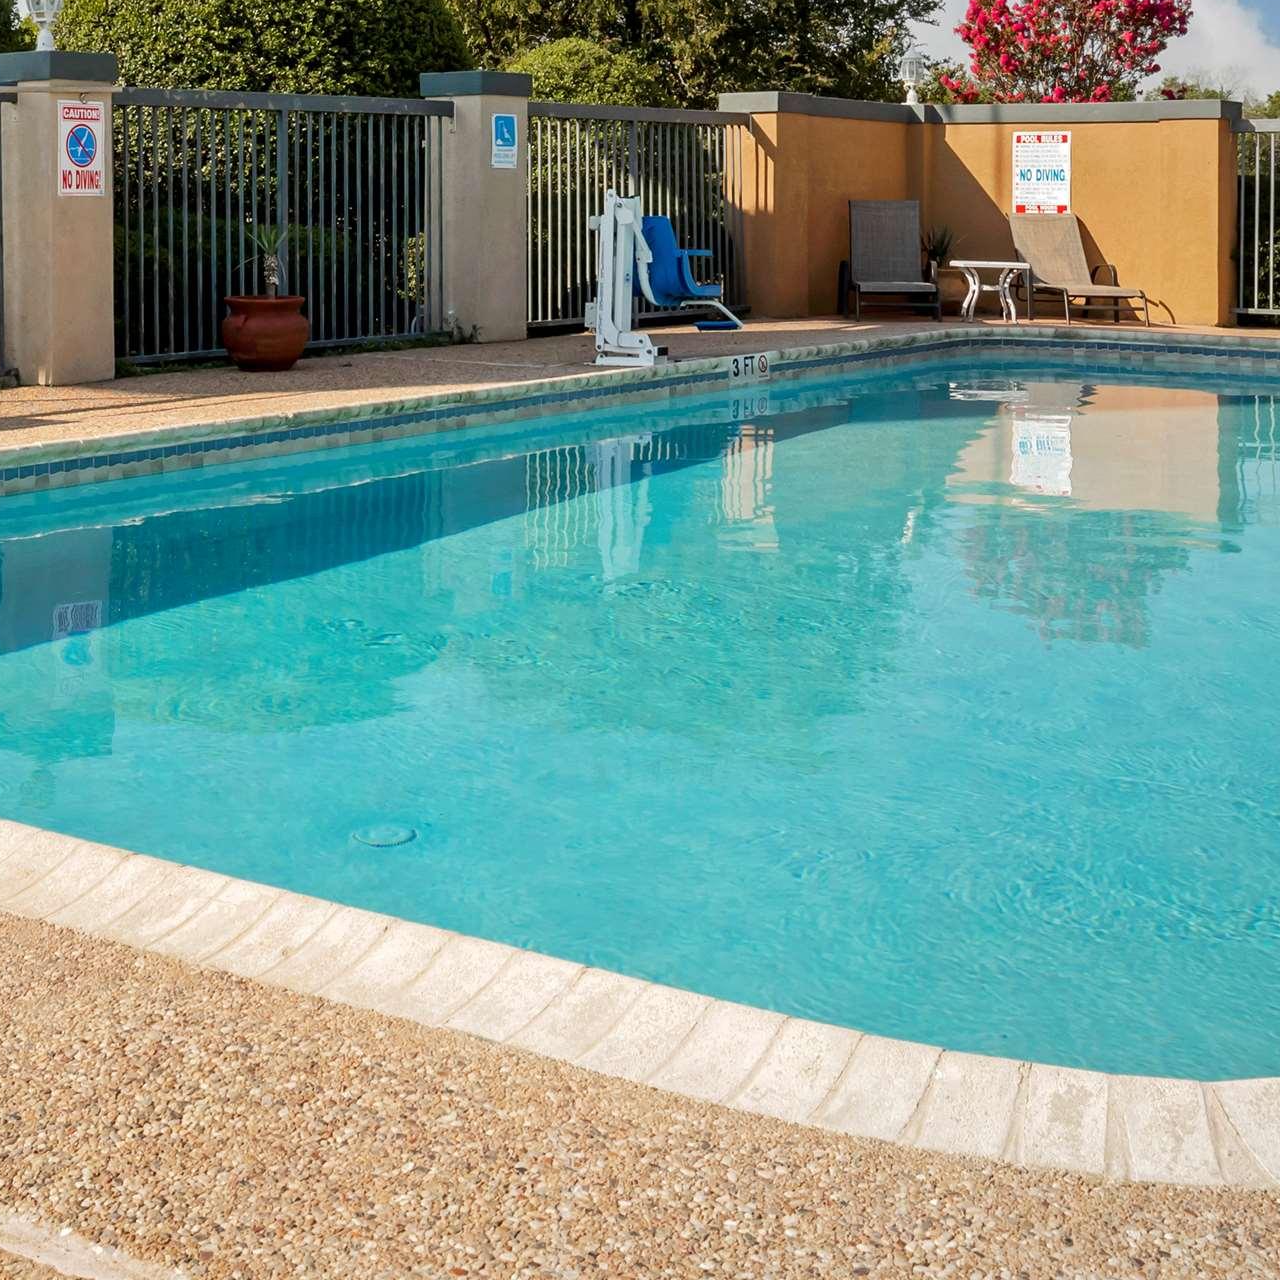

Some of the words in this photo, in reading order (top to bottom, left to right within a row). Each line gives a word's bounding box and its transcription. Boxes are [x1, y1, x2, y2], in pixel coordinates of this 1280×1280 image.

[63, 108, 100, 119] CAUTION!
[62, 170, 72, 189] NO
[76, 171, 101, 189] DIVING!
[1020, 169, 1032, 181] NO
[1036, 169, 1065, 181] DIVING
[732, 358, 740, 377] 3
[743, 355, 755, 376] FT
